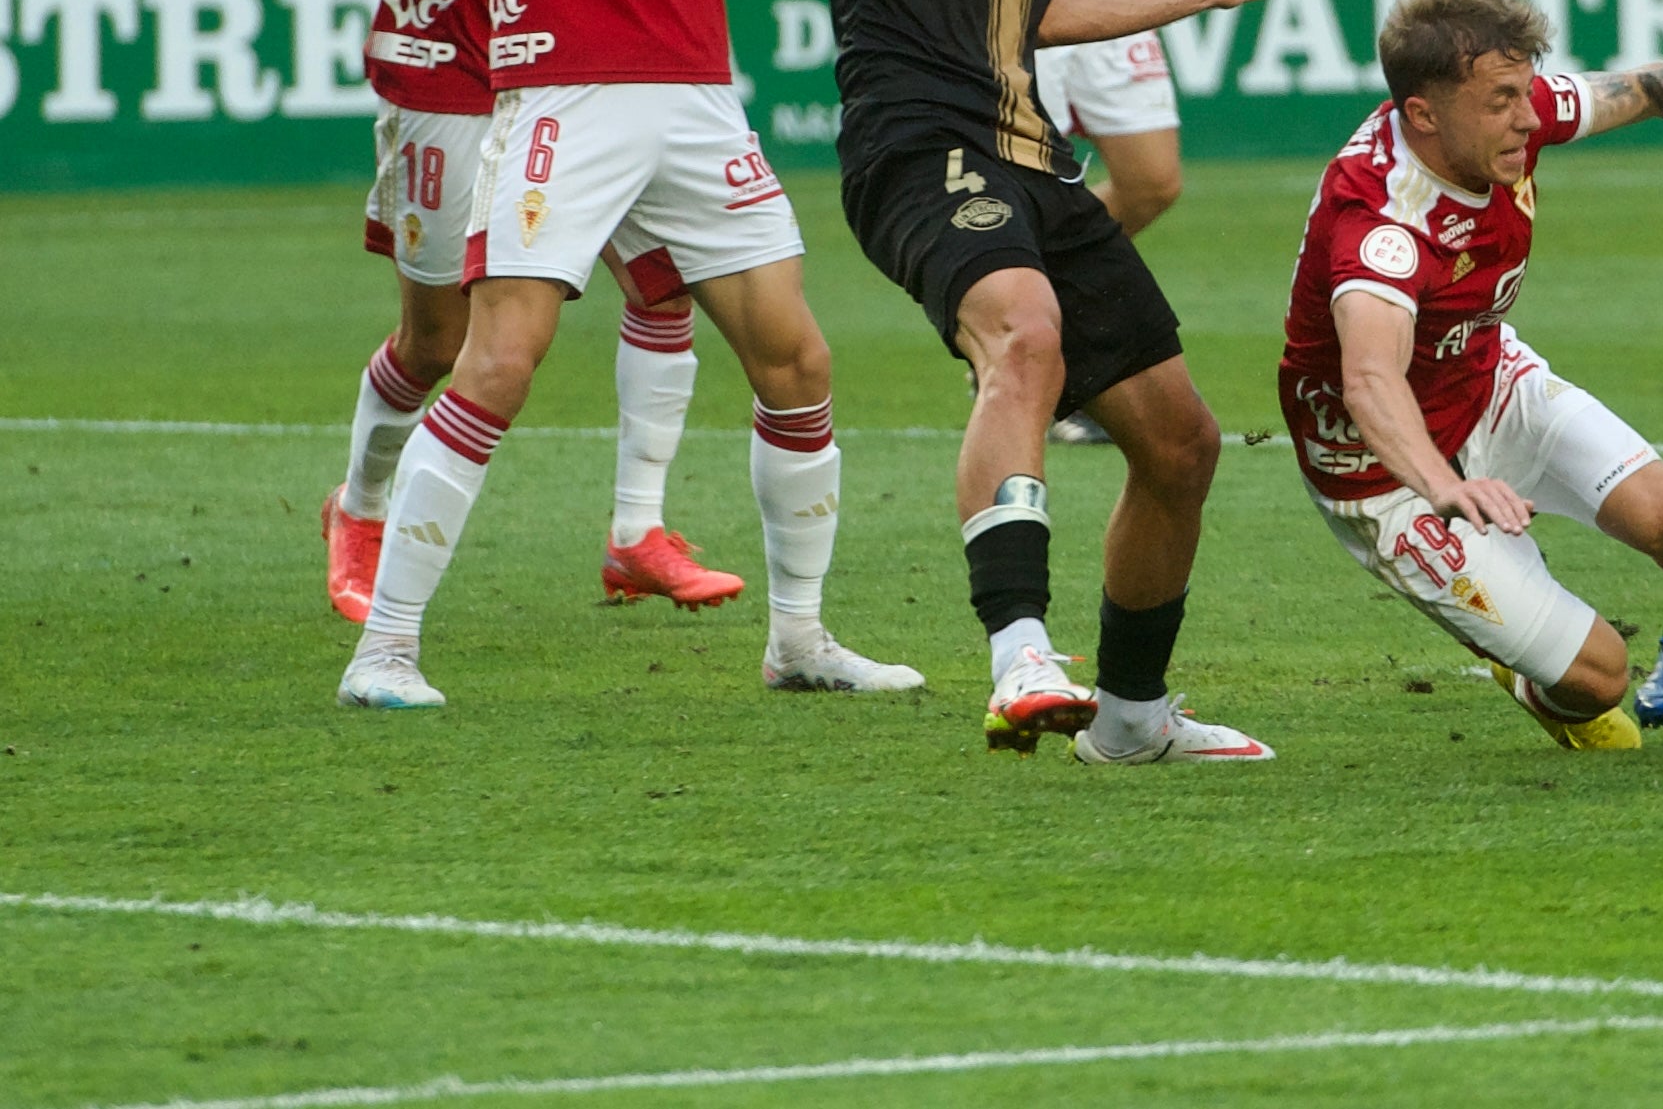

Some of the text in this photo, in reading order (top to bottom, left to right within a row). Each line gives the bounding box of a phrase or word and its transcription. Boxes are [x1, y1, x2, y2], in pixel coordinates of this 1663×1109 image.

[402, 141, 446, 211] 18
[525, 117, 560, 184] 6
[724, 151, 775, 189] CR
[945, 147, 987, 194] 4
[1394, 513, 1467, 590] 19
